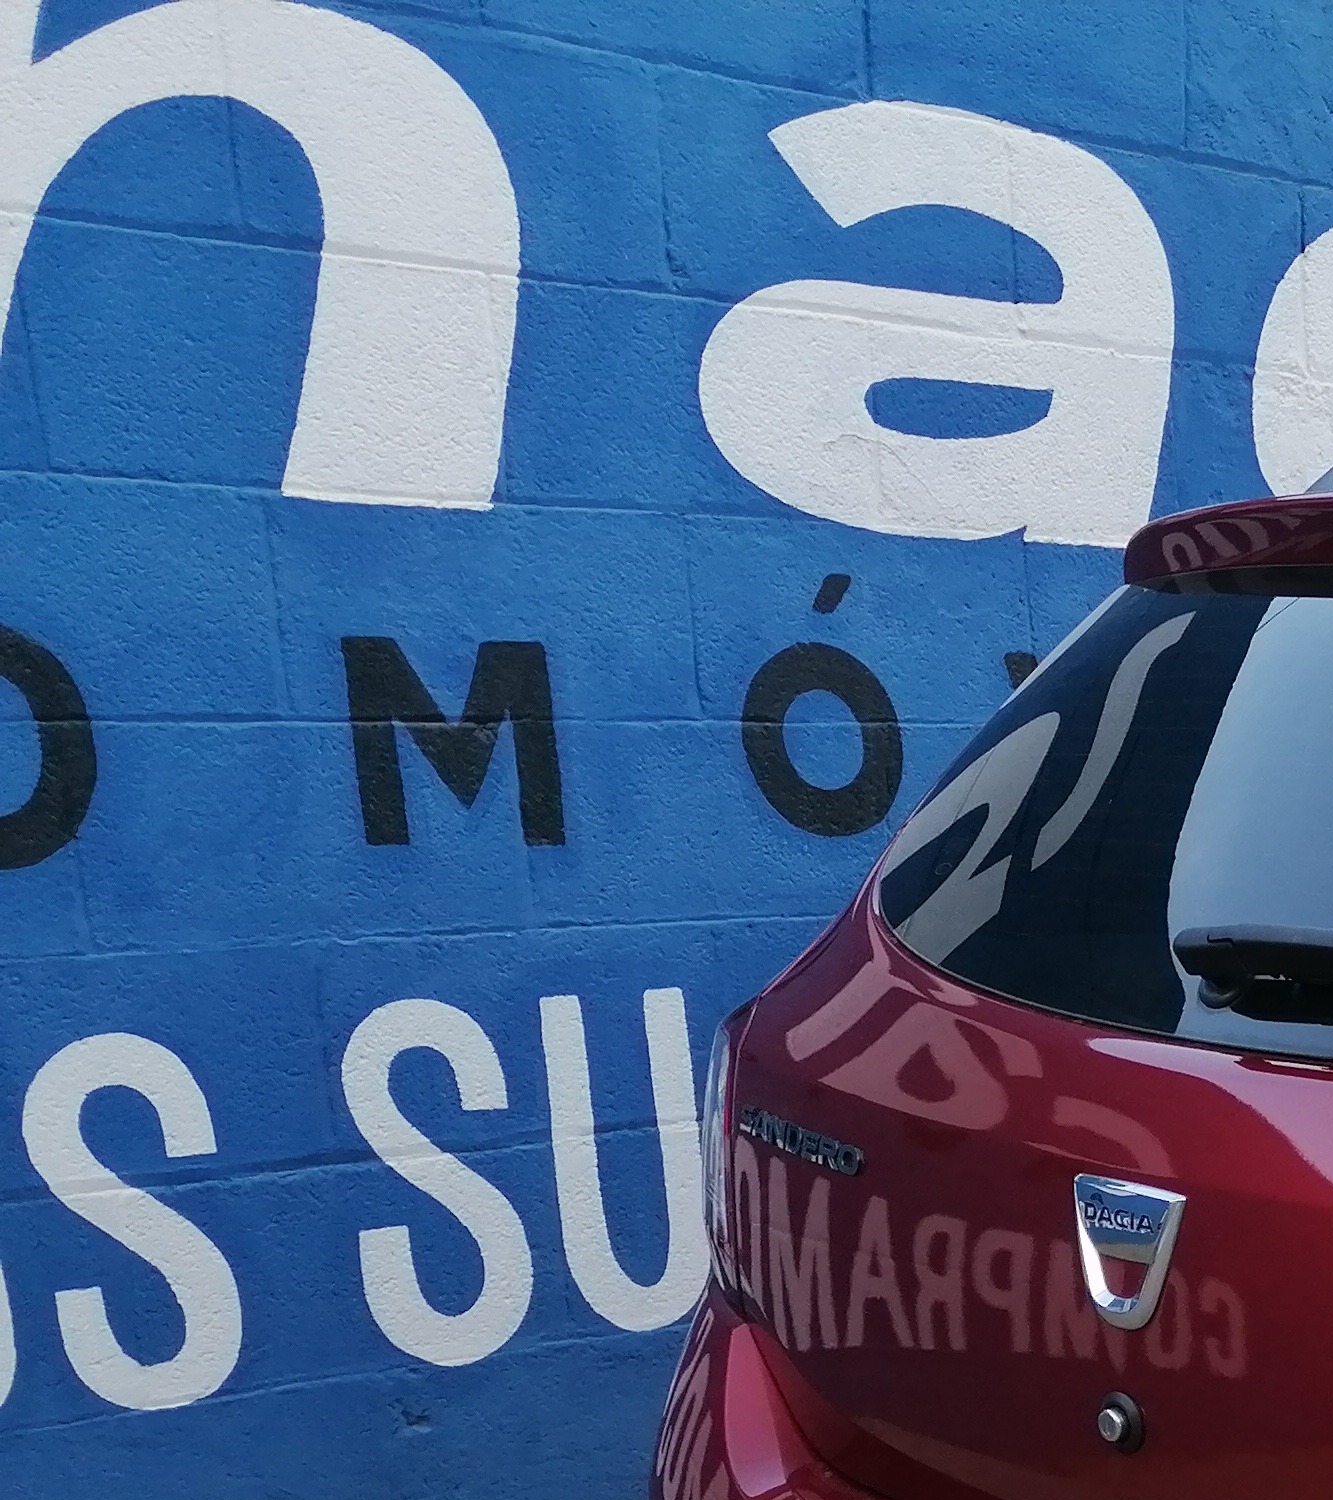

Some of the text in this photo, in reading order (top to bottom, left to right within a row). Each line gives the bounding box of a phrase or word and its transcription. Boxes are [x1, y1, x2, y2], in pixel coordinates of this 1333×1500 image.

[0, 573, 1037, 869] OMÓ
[739, 1103, 865, 1177] SANDERO
[1082, 1200, 1155, 1235] DACIA
